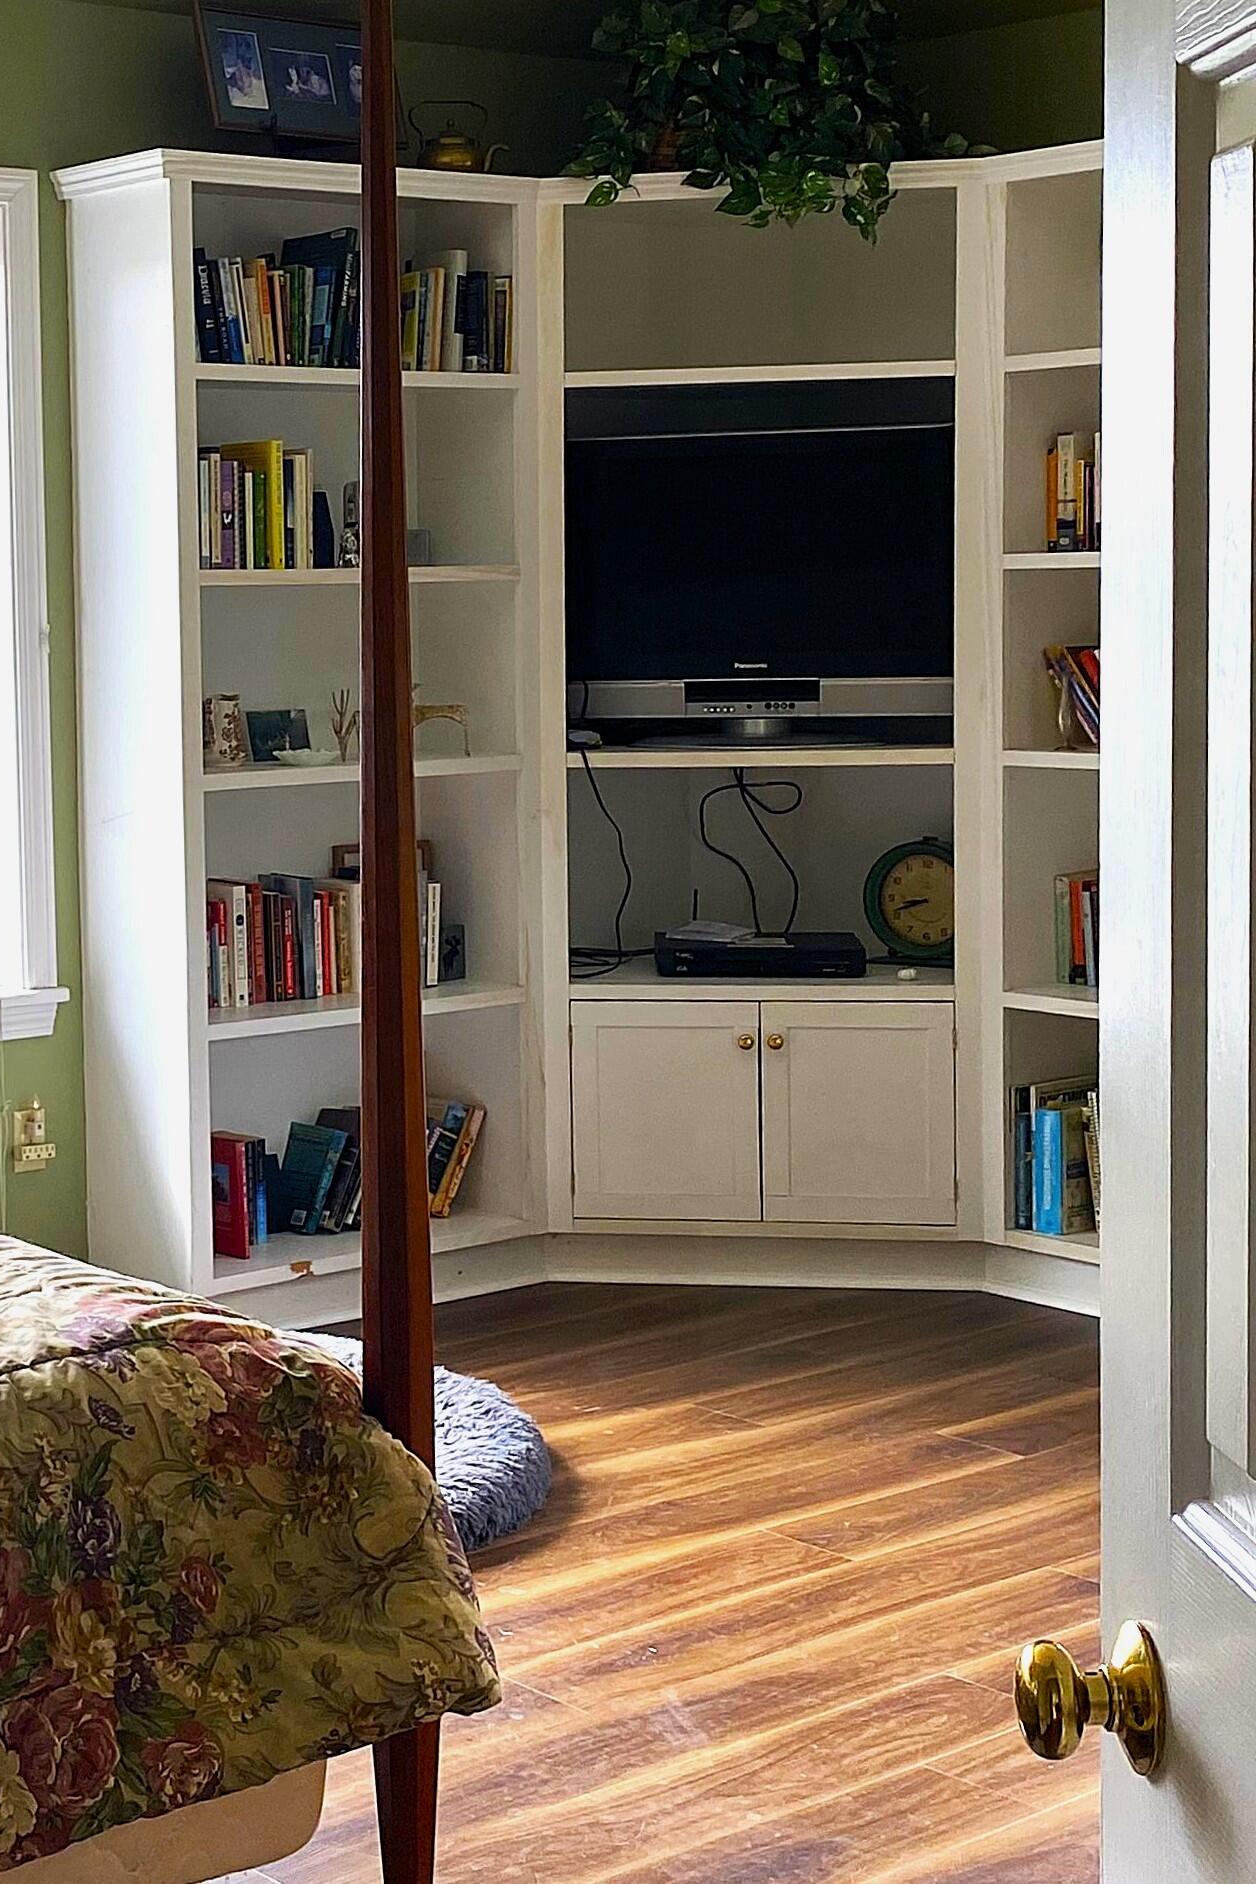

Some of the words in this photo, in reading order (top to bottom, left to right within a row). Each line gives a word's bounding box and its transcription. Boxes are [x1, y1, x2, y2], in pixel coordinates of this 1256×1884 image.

[922, 859, 934, 869] 12
[888, 894, 895, 902] 9
[906, 926, 914, 934] 7
[922, 932, 931, 941] 6
